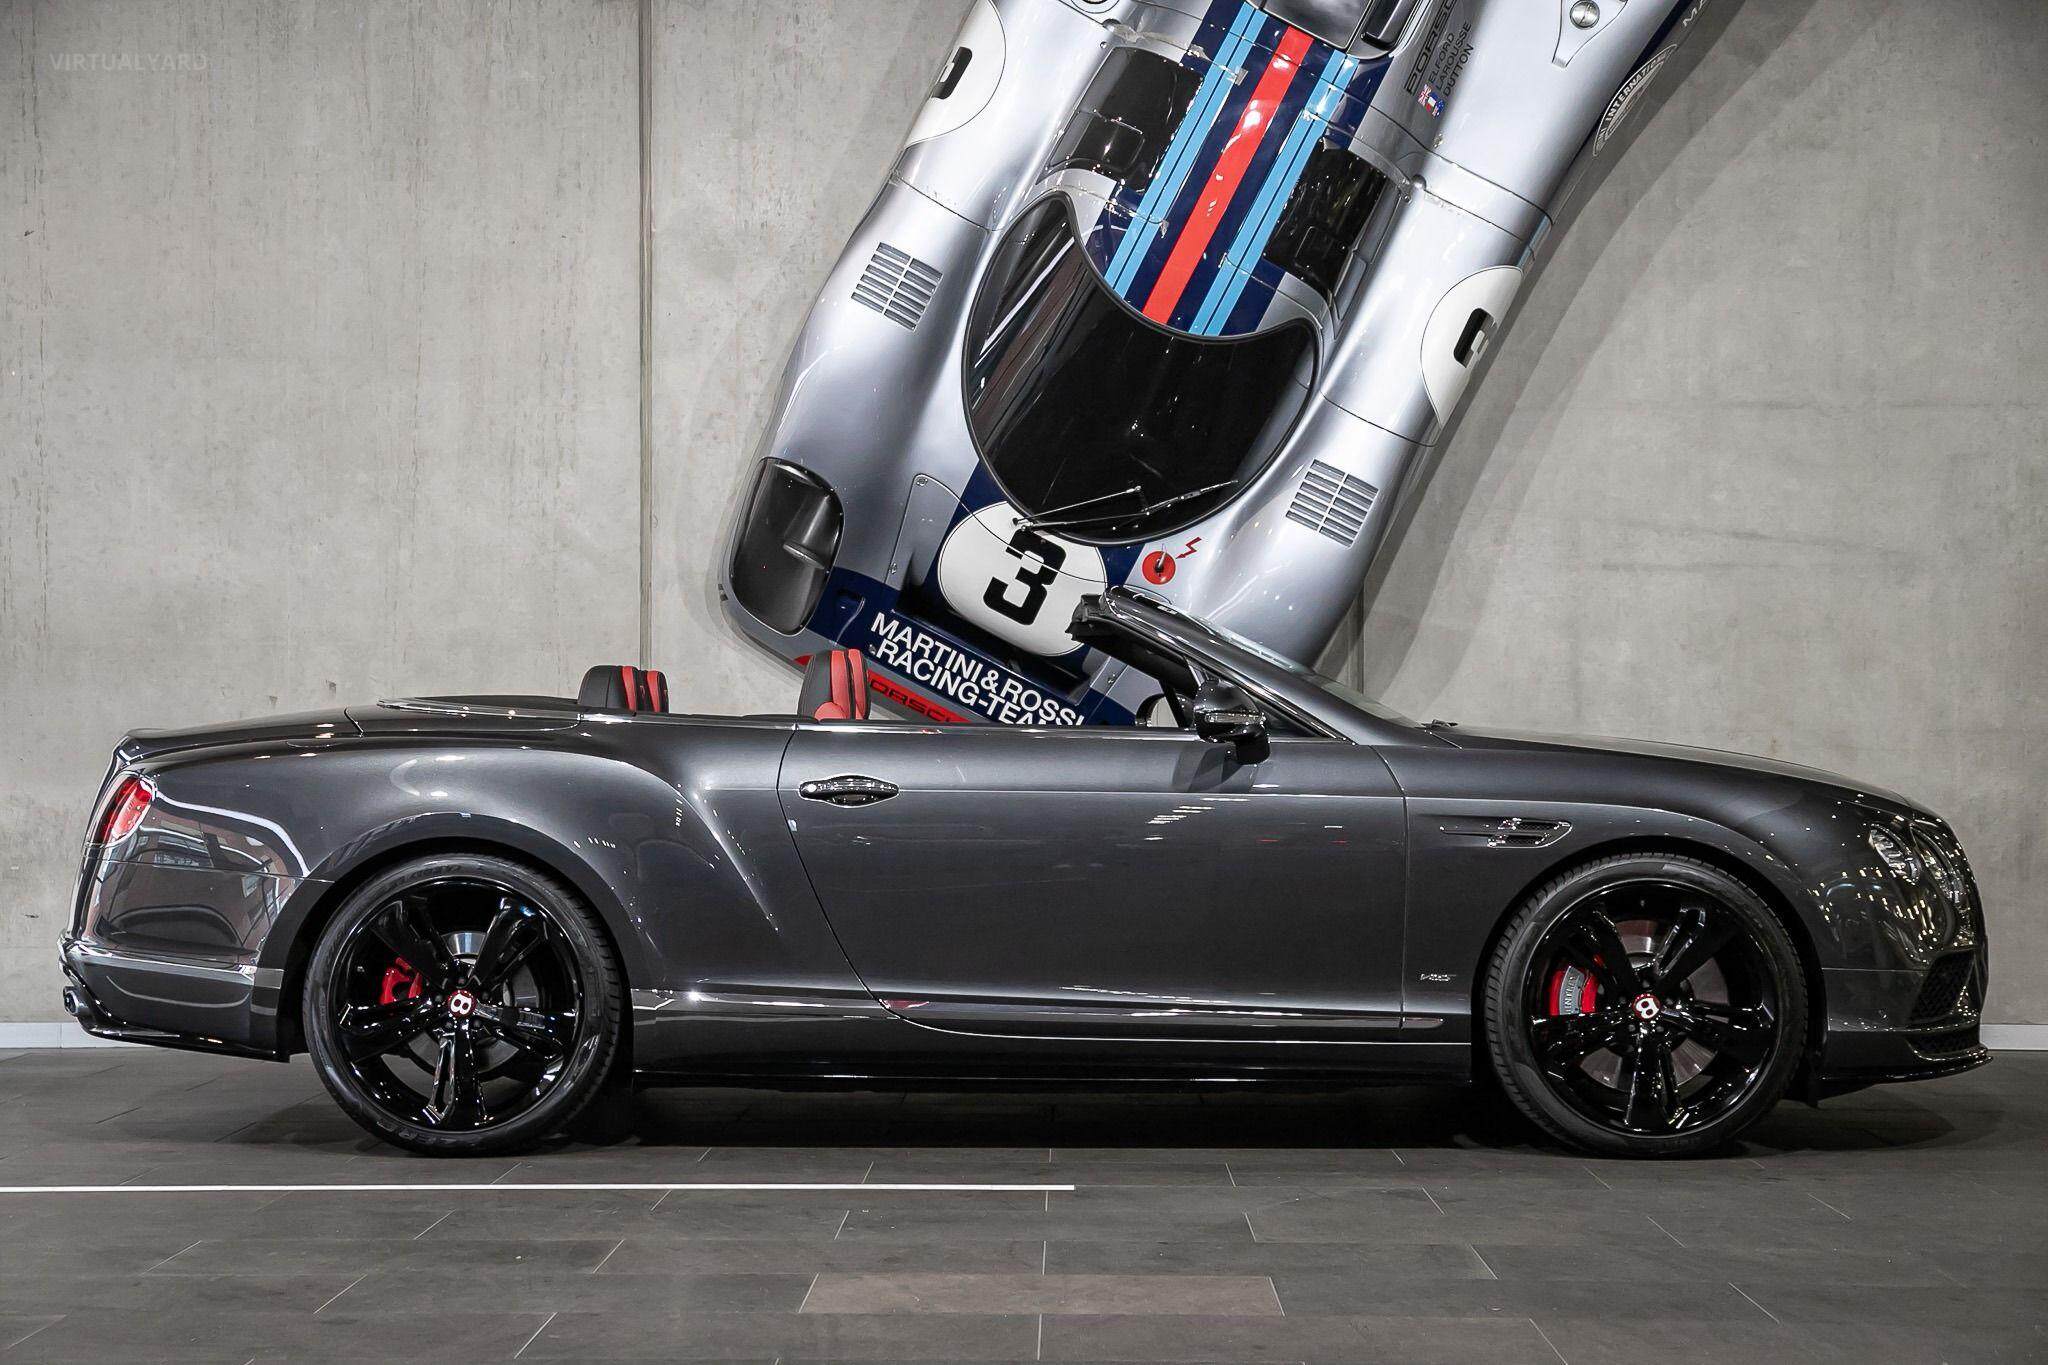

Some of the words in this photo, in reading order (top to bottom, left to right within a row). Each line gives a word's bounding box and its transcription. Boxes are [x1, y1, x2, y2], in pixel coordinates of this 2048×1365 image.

[1428, 32, 1455, 84] ELFORD
[1436, 21, 1472, 91] LAROUSSE
[1443, 43, 1475, 97] DUTTON
[983, 528, 1066, 626] 3
[870, 612, 982, 683] MARTINI
[877, 638, 1057, 725] RACING-TEA
